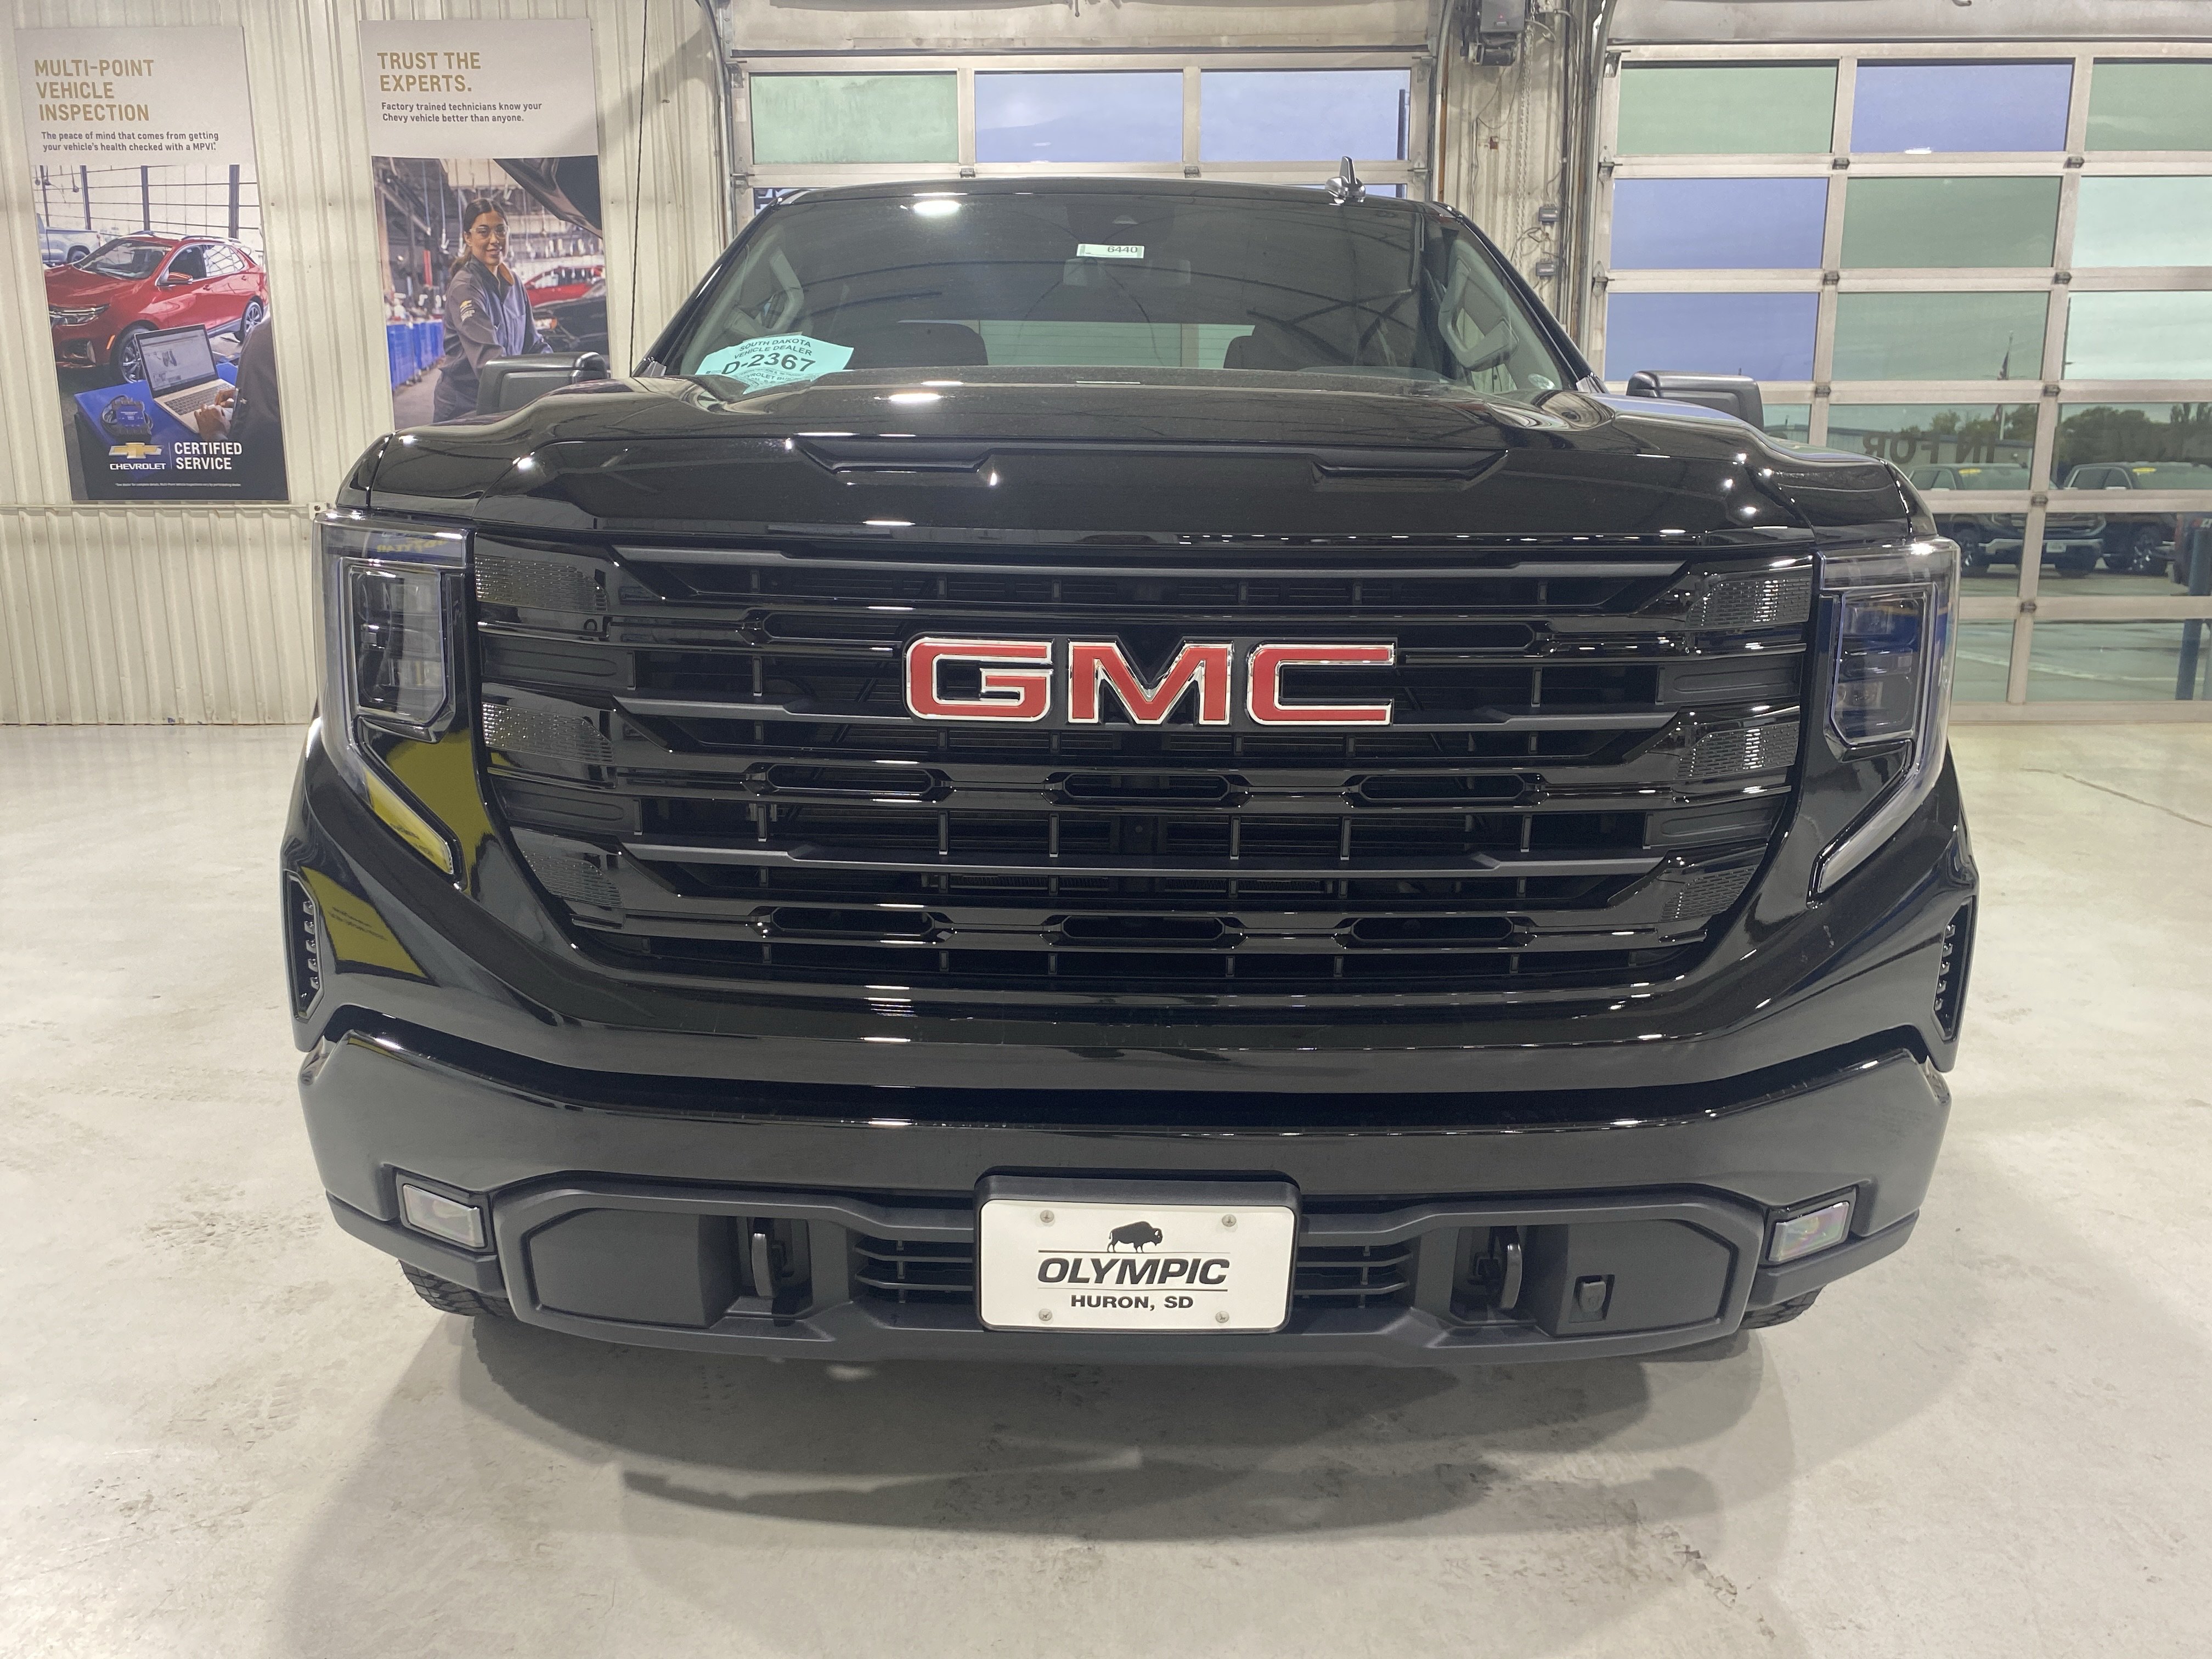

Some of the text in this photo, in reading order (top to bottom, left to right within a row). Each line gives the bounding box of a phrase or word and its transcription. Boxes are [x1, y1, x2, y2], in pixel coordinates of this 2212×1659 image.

[35, 59, 154, 76] MULTI-POINT
[377, 52, 481, 70] TRUST THE
[36, 82, 114, 99] VEHICLE
[380, 75, 472, 92] EXPERTS.
[39, 104, 149, 121] INSPECTION
[381, 103, 414, 112] Factory
[416, 103, 446, 111] trained
[449, 103, 496, 111] technicians
[523, 103, 542, 111] your
[382, 114, 408, 123] Chevy
[492, 114, 524, 123] anyone.
[59, 133, 83, 141] peace
[189, 132, 219, 142] getting
[43, 144, 61, 152] your
[100, 143, 127, 151] health
[129, 143, 163, 151] checked
[165, 143, 183, 151] with
[735, 345, 812, 359] VEHICLE DEALER
[740, 338, 811, 351] SOUTH DAKOTA
[721, 353, 816, 374] D-2367
[174, 442, 242, 455] CERTIFIED
[176, 457, 232, 470] SERVICE
[905, 635, 1395, 726] GMC
[1037, 1257, 1231, 1285] OLYMPIC
[1071, 1295, 1194, 1311] HURON, SD
